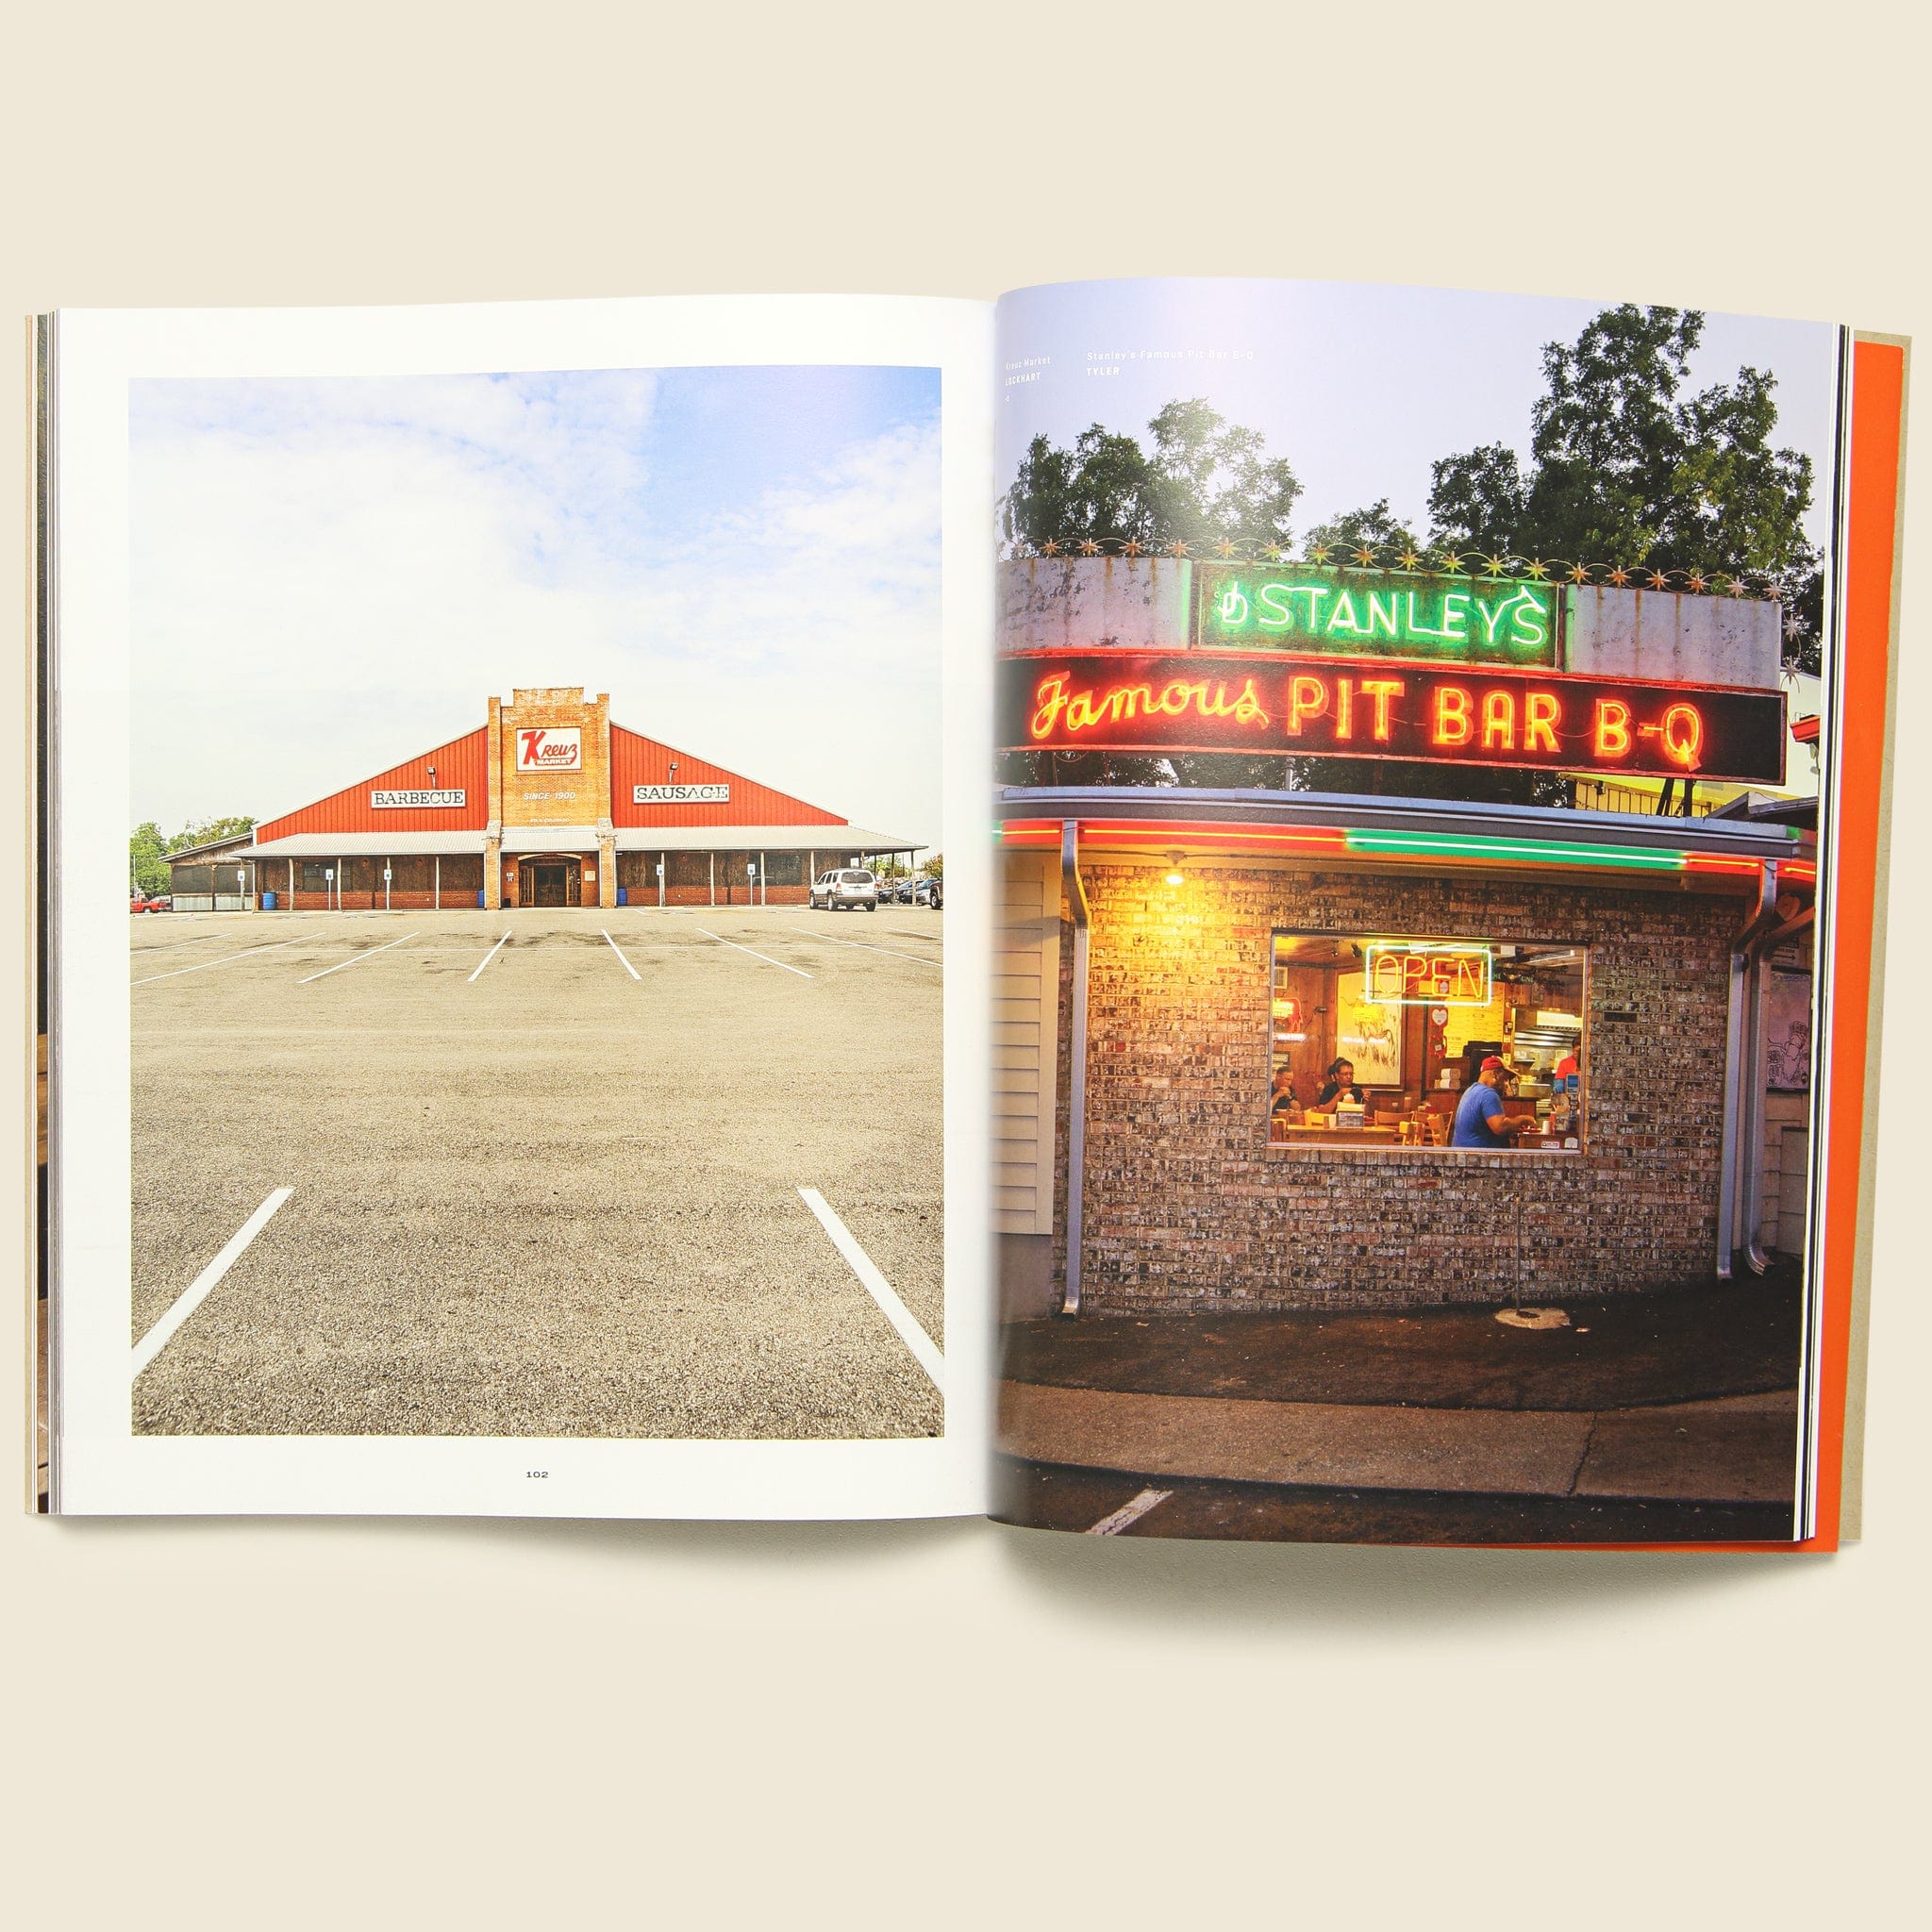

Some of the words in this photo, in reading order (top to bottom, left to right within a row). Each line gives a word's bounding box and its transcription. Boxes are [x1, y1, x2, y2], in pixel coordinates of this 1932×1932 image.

[1141, 350, 1183, 359] Famous
[1188, 350, 1205, 359] Pit
[1208, 350, 1229, 359] Bar
[1024, 356, 1052, 368] Market
[1086, 366, 1121, 376] TYLER
[1031, 671, 1270, 740] Famous
[1286, 675, 1406, 741] PIT
[1432, 686, 1562, 754] BAR
[1594, 697, 1705, 773] B-Q
[374, 791, 464, 806] BARBECUE
[524, 792, 551, 801] SINCE
[554, 791, 576, 800] 1900
[637, 785, 728, 800] SAUSAGE
[1374, 955, 1487, 999] OPEN
